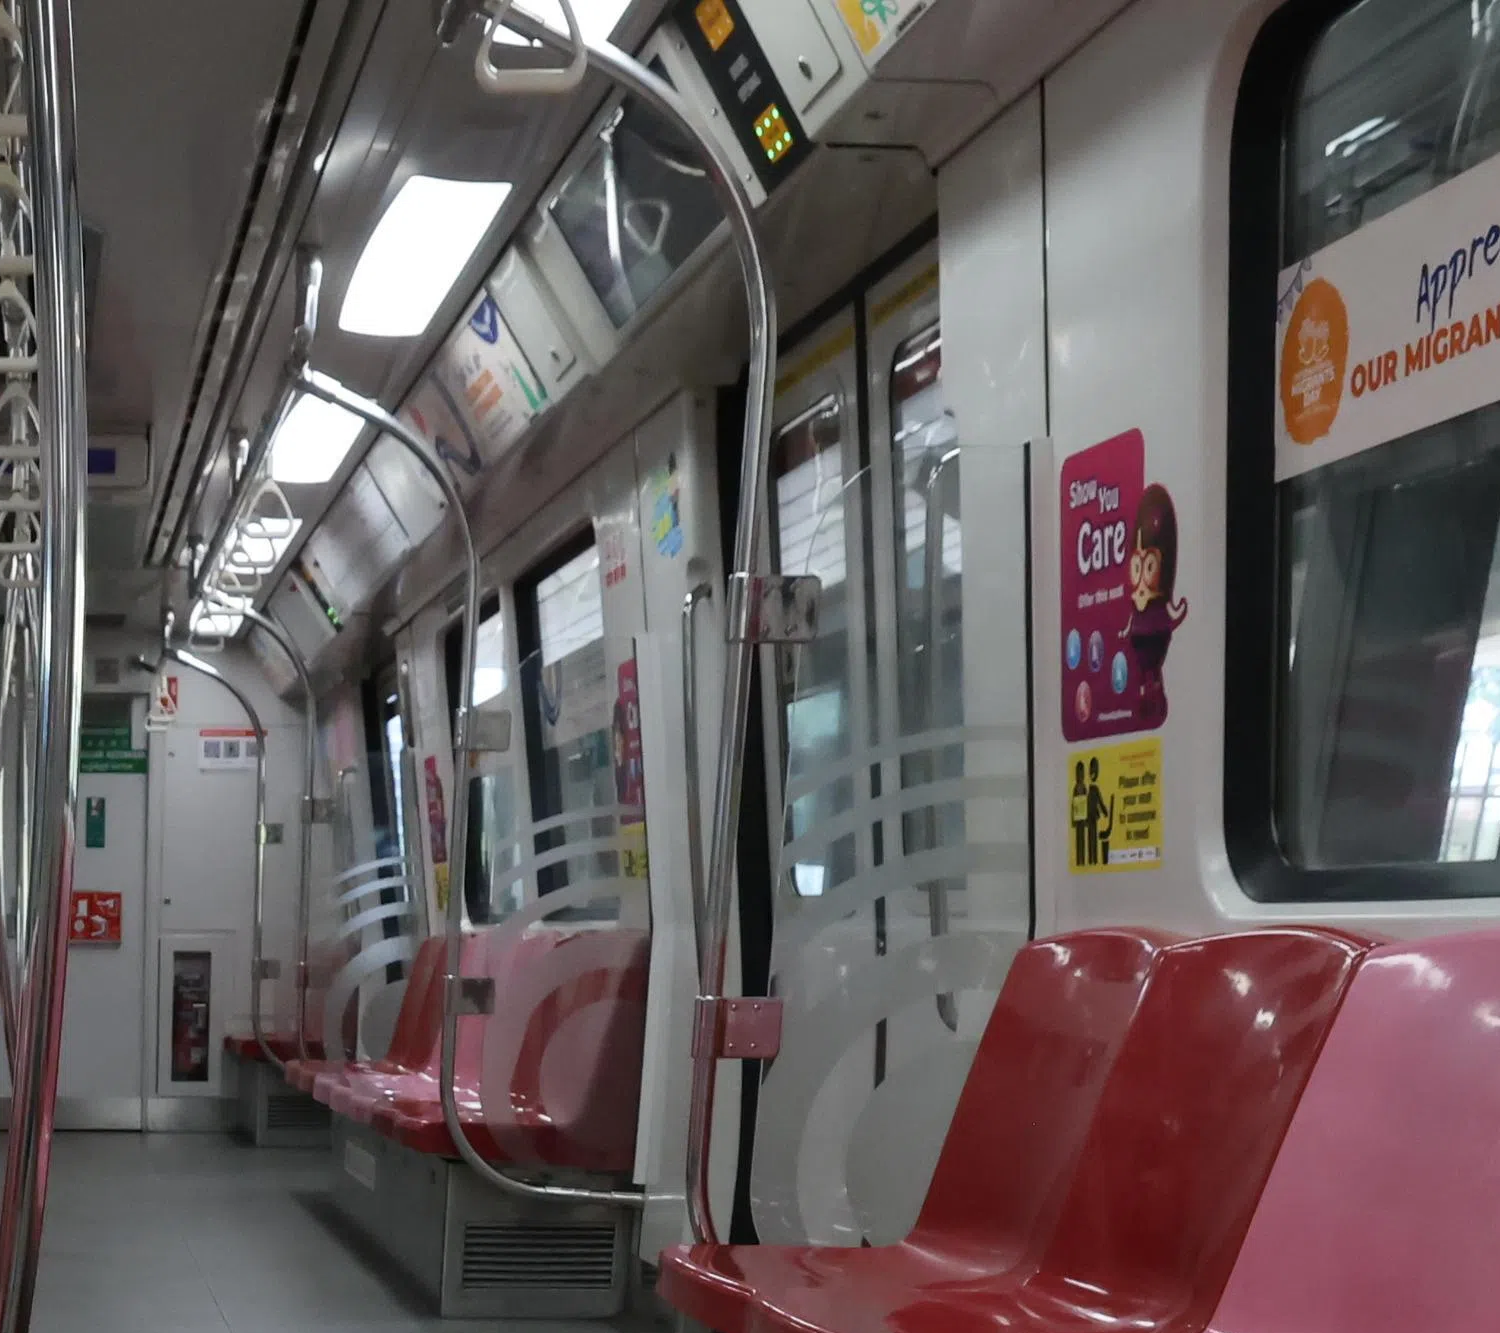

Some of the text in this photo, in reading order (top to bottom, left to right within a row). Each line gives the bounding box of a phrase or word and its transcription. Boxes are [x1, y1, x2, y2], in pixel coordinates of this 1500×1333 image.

[1351, 350, 1398, 398] OUR
[1069, 479, 1119, 513] Show You
[1078, 520, 1126, 575] Care
